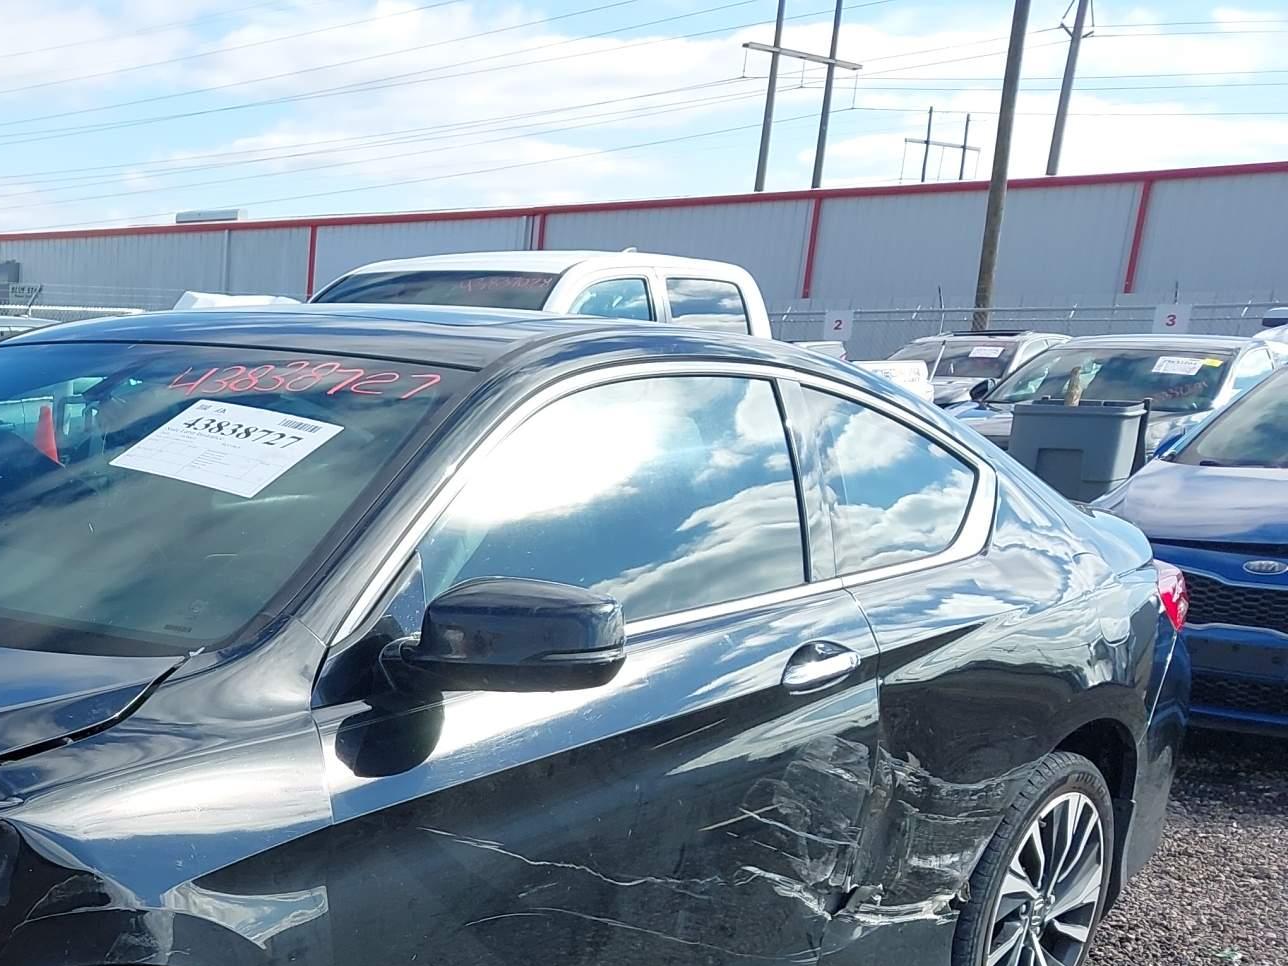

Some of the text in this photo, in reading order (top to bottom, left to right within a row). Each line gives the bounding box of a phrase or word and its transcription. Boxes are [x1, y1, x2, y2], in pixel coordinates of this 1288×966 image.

[833, 319, 843, 331] 2
[1165, 314, 1177, 327] 3
[168, 361, 441, 399] 43838727
[184, 417, 304, 448] 43838727
